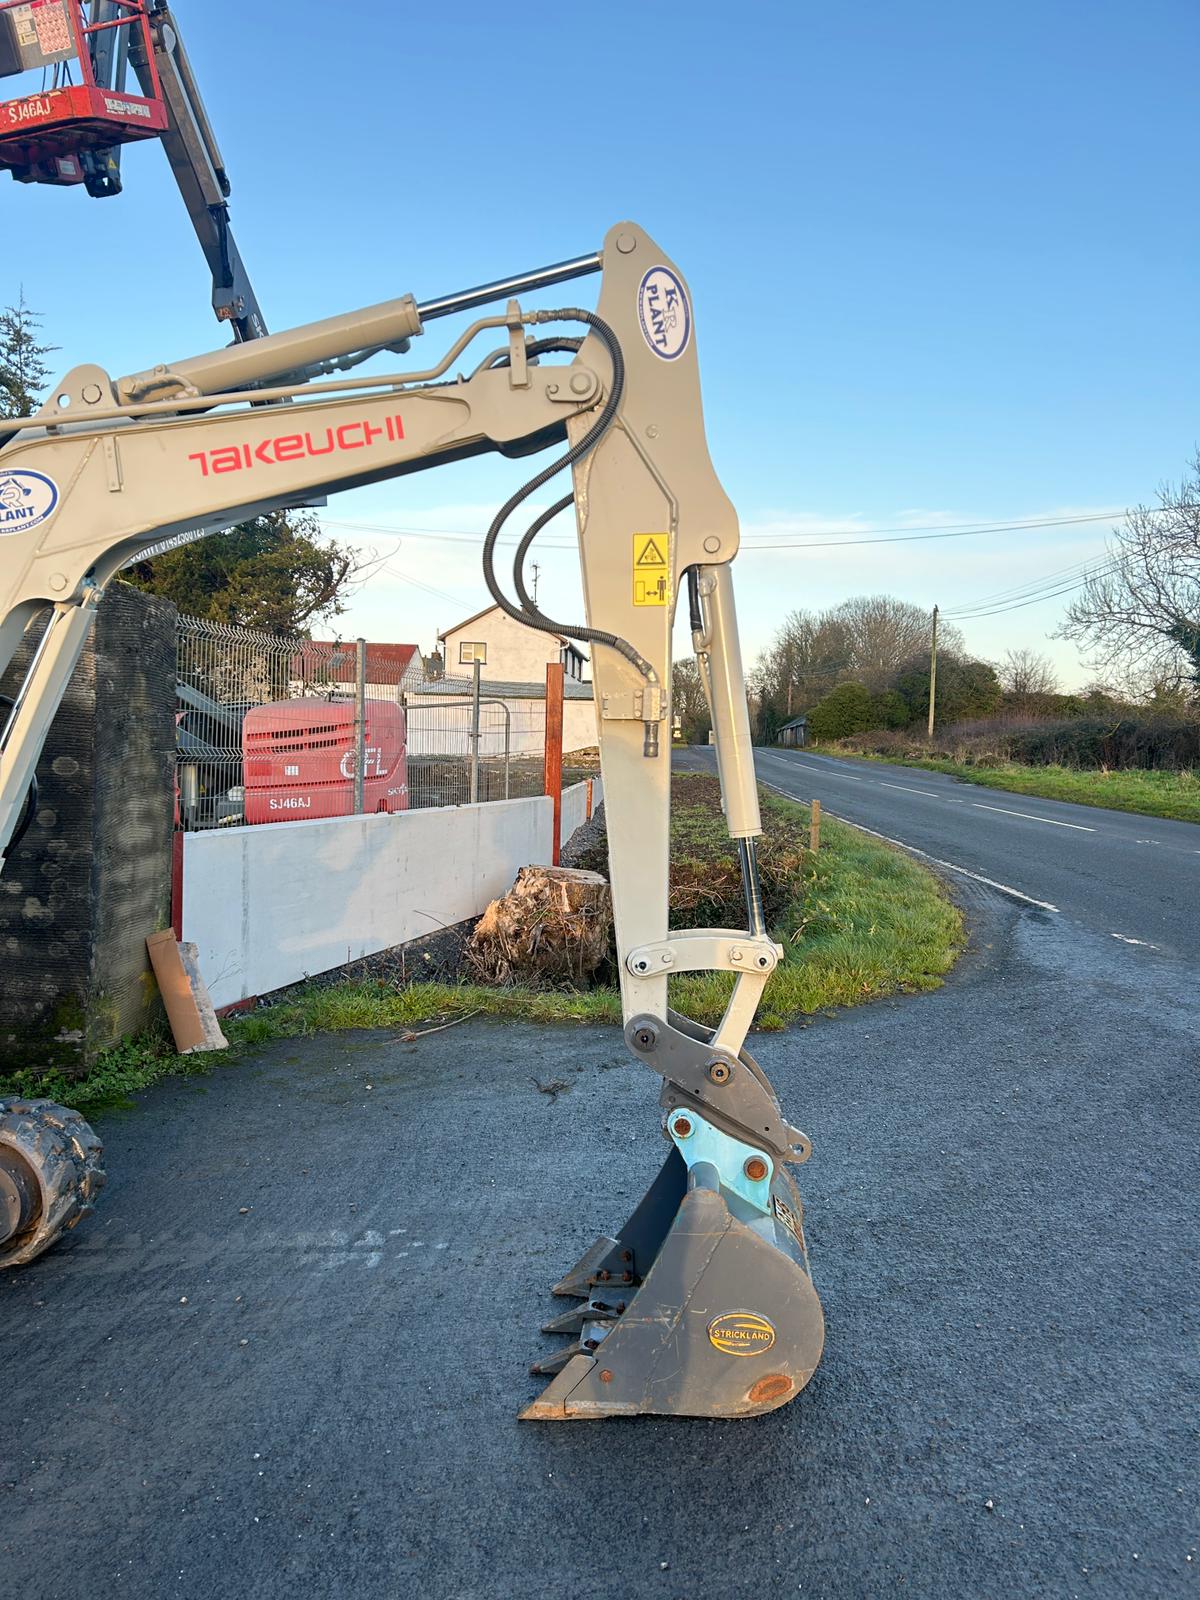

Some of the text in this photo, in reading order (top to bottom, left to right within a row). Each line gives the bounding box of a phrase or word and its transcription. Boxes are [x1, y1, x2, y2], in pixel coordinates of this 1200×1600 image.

[646, 283, 667, 347] PLANT
[269, 796, 311, 809] SJ46AJ
[714, 1329, 770, 1341] STRICKLAND
